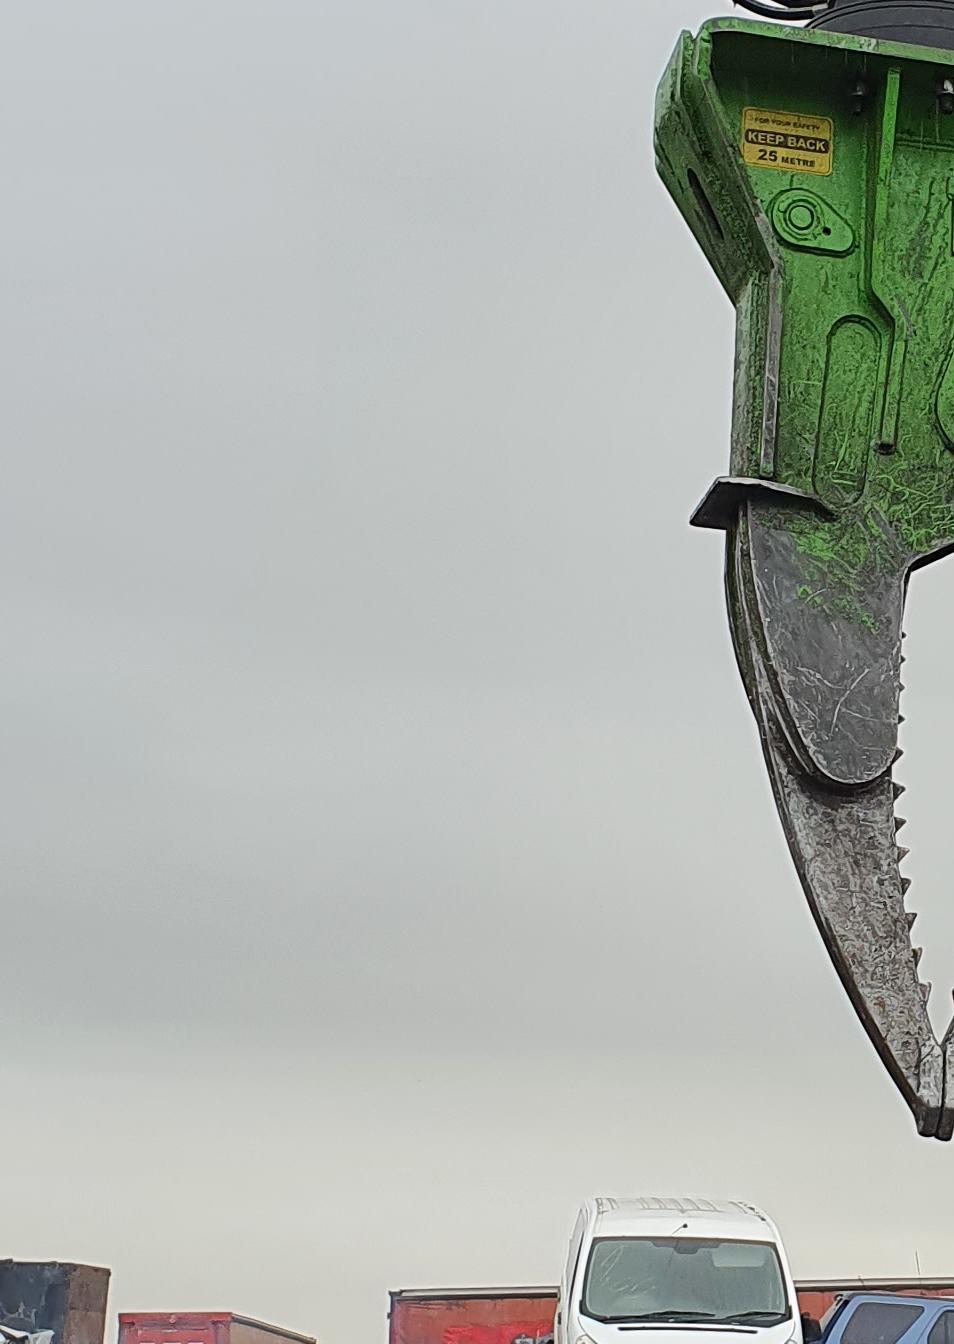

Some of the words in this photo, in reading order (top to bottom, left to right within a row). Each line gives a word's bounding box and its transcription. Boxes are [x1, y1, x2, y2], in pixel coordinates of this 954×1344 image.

[748, 131, 785, 145] KEEP
[787, 136, 826, 152] BACK
[758, 149, 778, 162] 25
[781, 156, 816, 168] METRE
